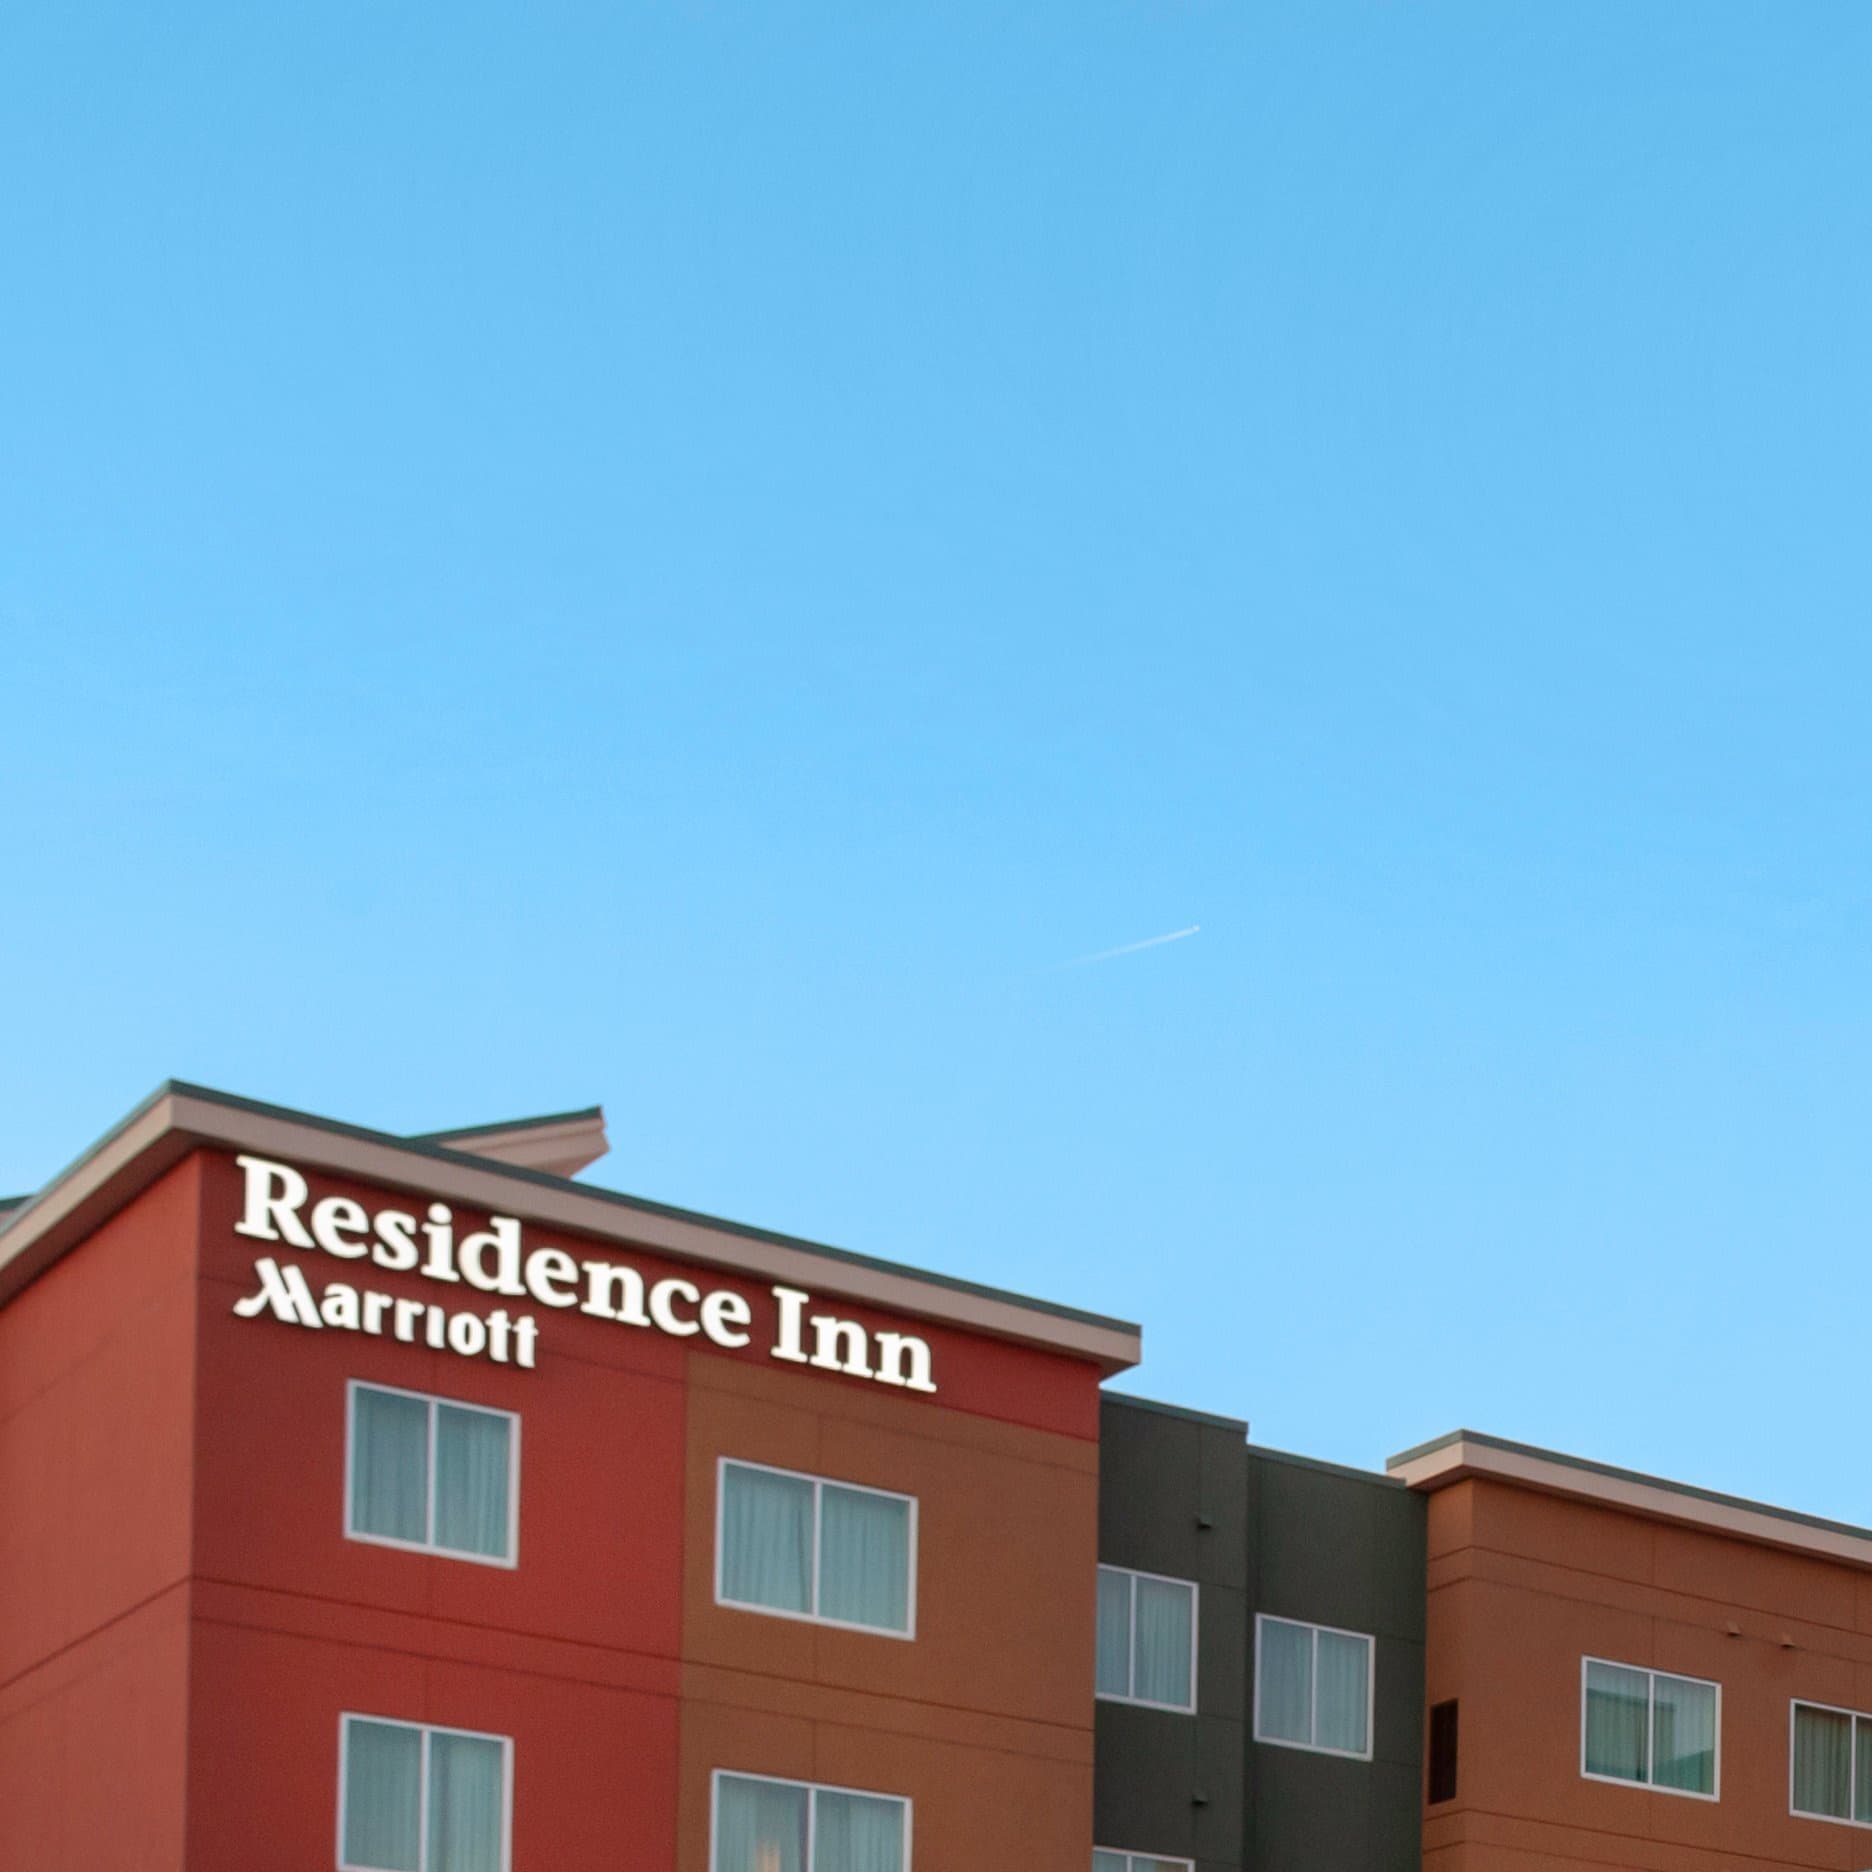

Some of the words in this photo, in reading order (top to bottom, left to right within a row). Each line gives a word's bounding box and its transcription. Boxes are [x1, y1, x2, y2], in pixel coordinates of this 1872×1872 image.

[233, 1257, 539, 1368] Marriott
[234, 1155, 752, 1349] Residence
[770, 1286, 938, 1393] Inn
